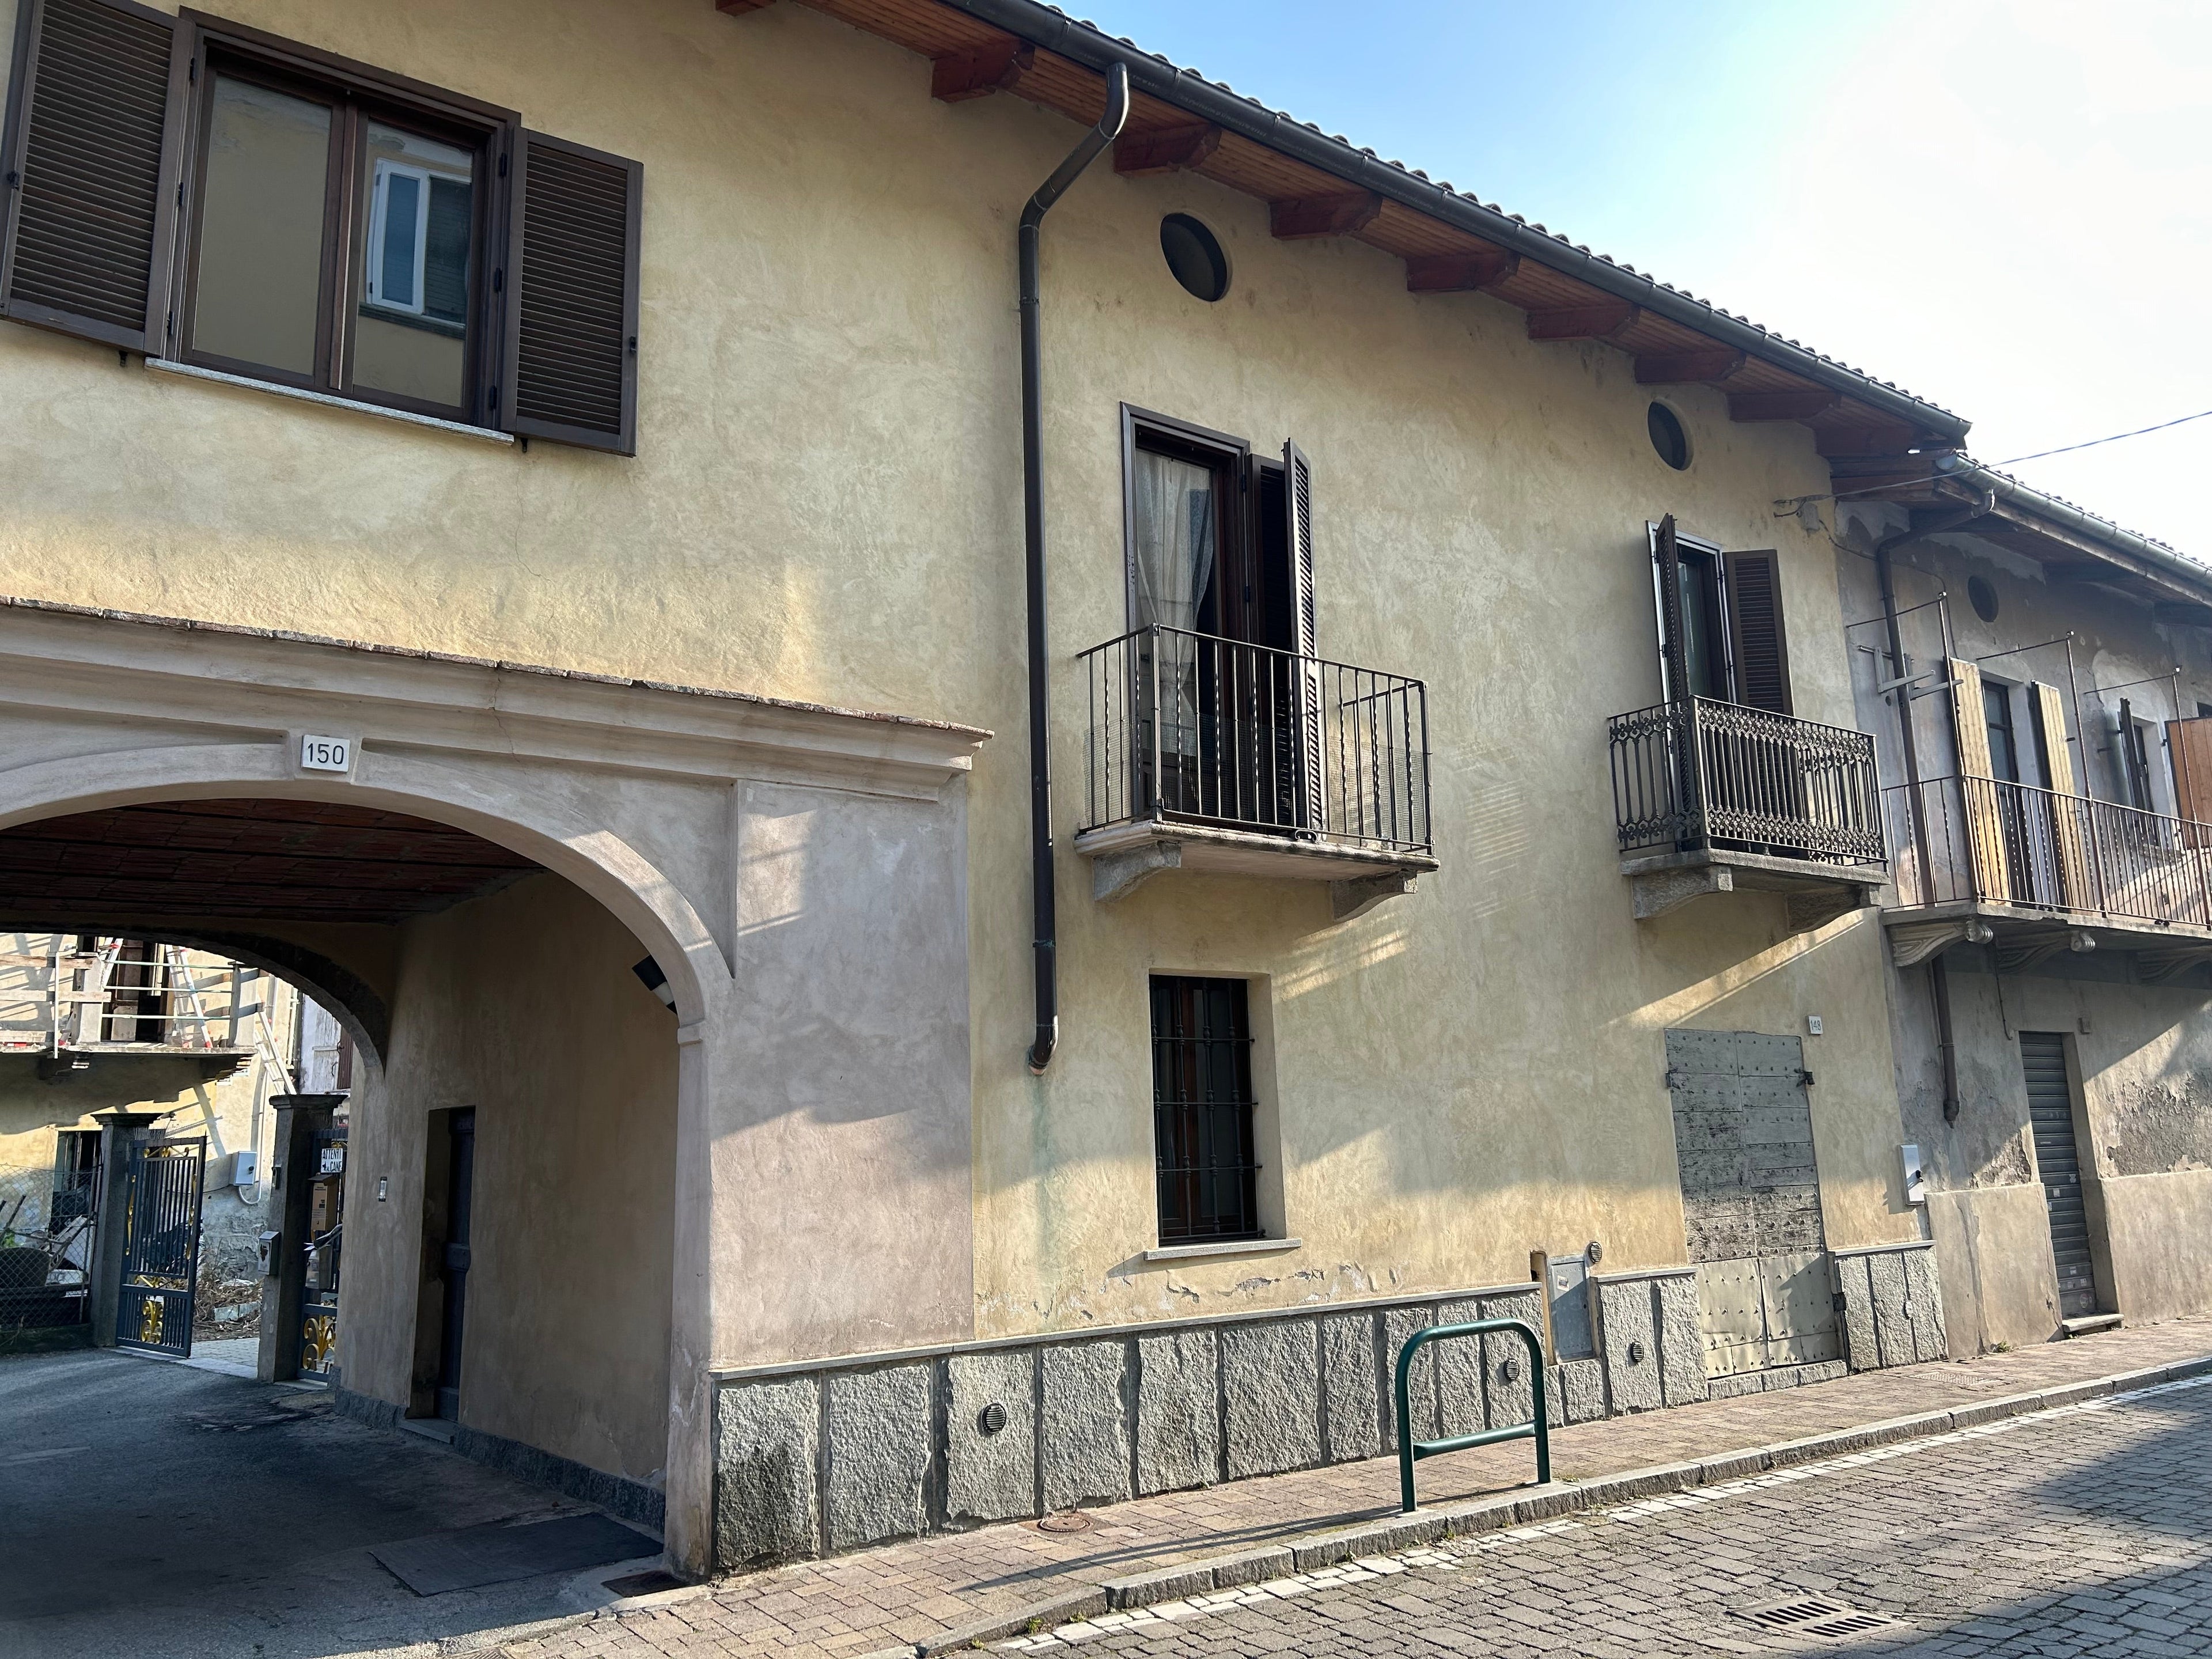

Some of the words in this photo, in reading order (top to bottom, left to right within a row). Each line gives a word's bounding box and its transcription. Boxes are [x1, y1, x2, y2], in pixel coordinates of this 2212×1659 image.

[308, 743, 344, 764] 150
[1810, 1020, 1821, 1031] 148
[323, 1149, 342, 1159] ATTENTI
[330, 1161, 342, 1172] CANE
